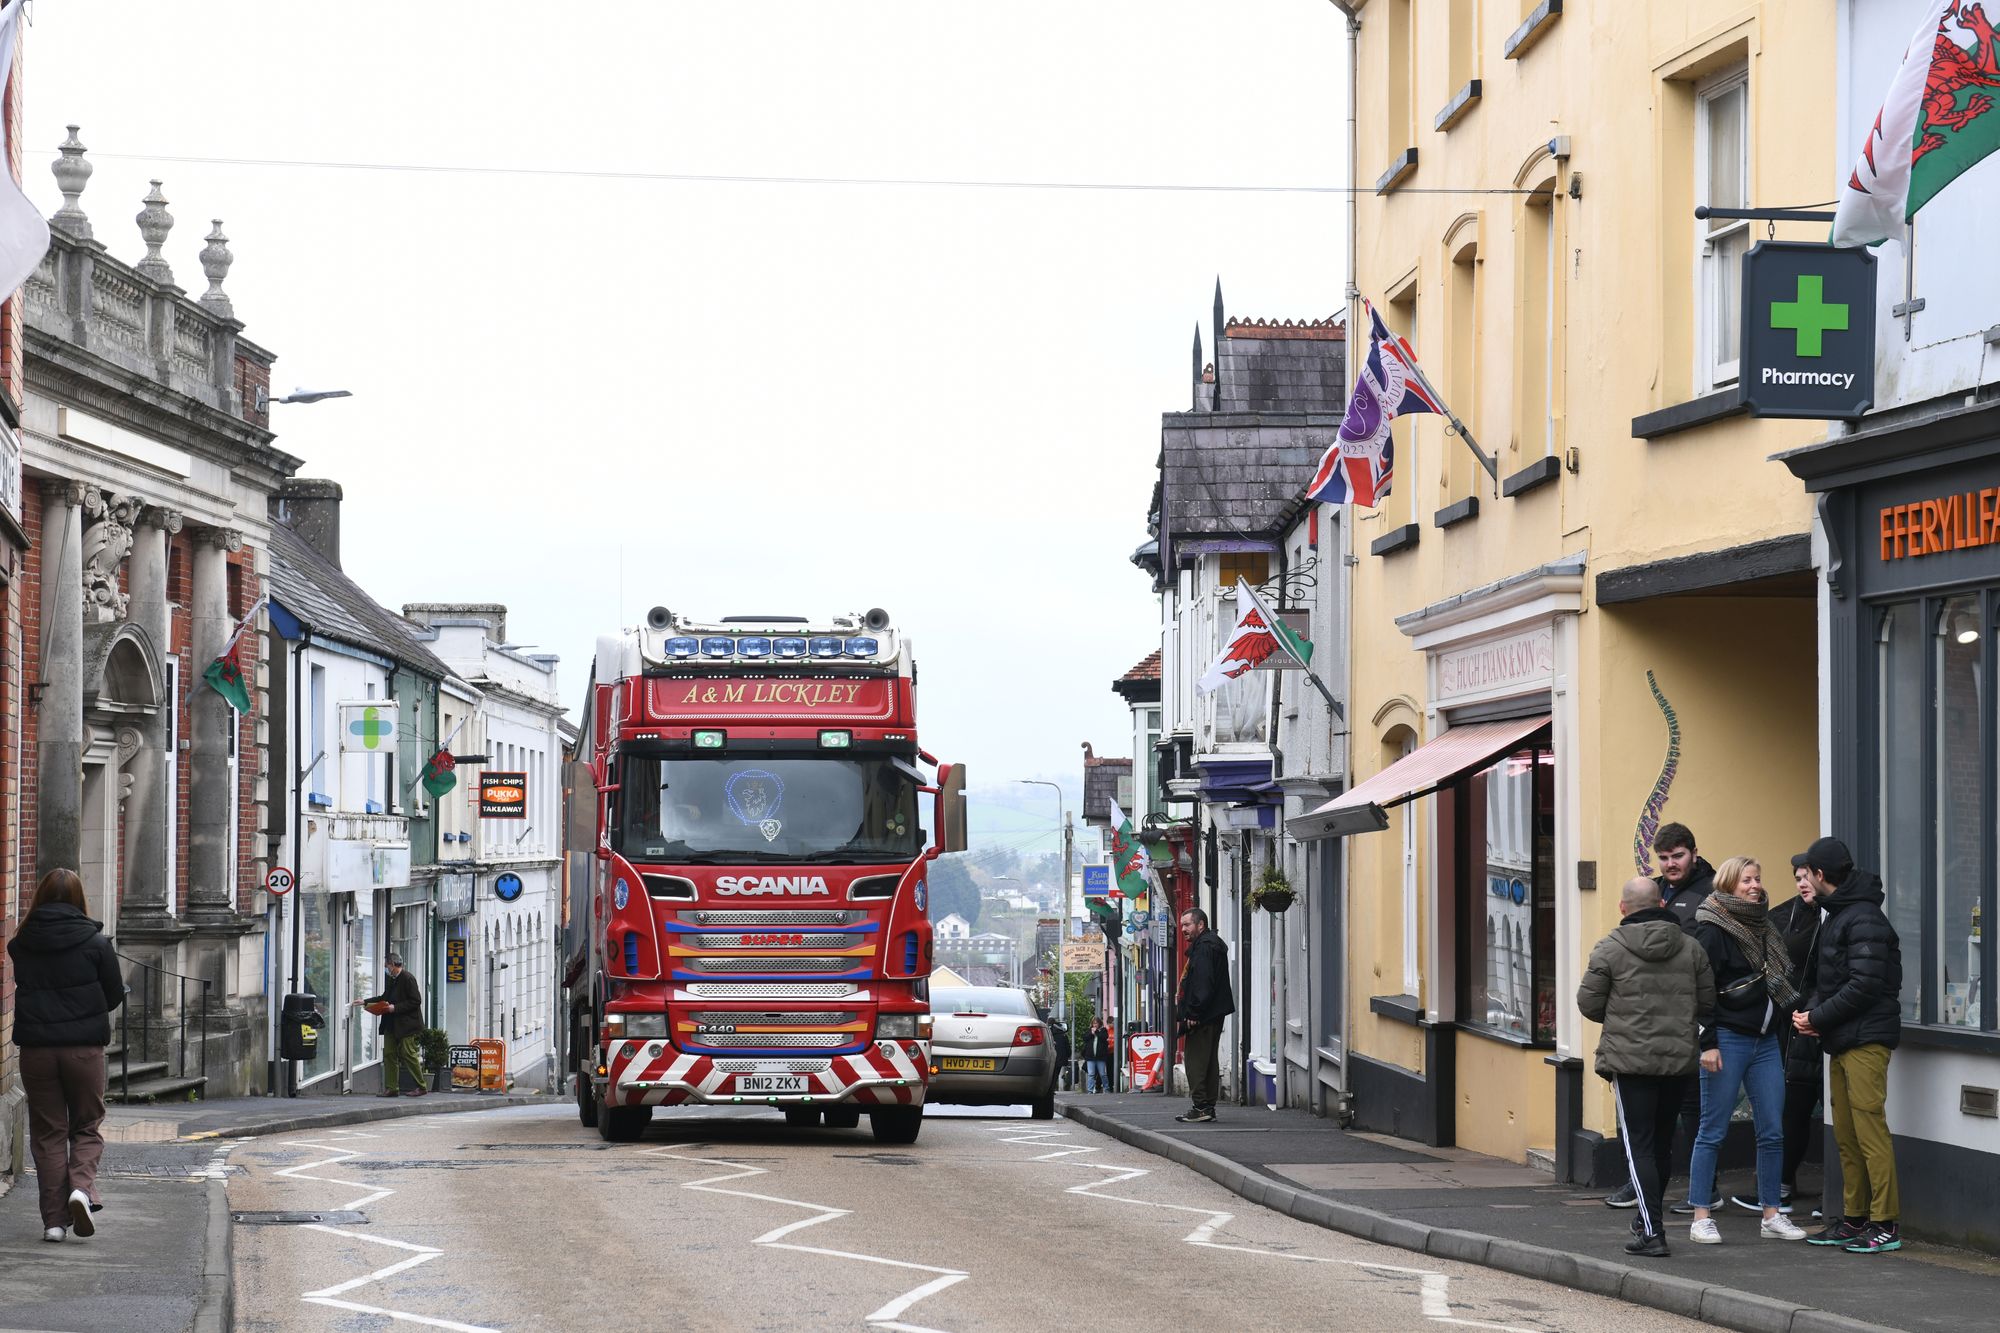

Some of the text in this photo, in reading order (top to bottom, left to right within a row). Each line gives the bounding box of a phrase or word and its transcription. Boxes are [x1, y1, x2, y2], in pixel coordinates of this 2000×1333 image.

[1762, 368, 1855, 389] Pharmacy
[1456, 653, 1480, 690] HUGH
[1482, 646, 1507, 684] EVANS
[1509, 644, 1515, 680] &
[1516, 639, 1534, 678] SON
[681, 684, 861, 707] A & M LICKLEY
[487, 789, 519, 798] PUKKA
[270, 875, 290, 887] 20
[715, 876, 829, 895] SCANIA
[741, 935, 803, 945] SUPER
[447, 941, 465, 981] CHIPS
[946, 1059, 991, 1069] HV07 OJE
[743, 1078, 801, 1090] BN12 ZKX
